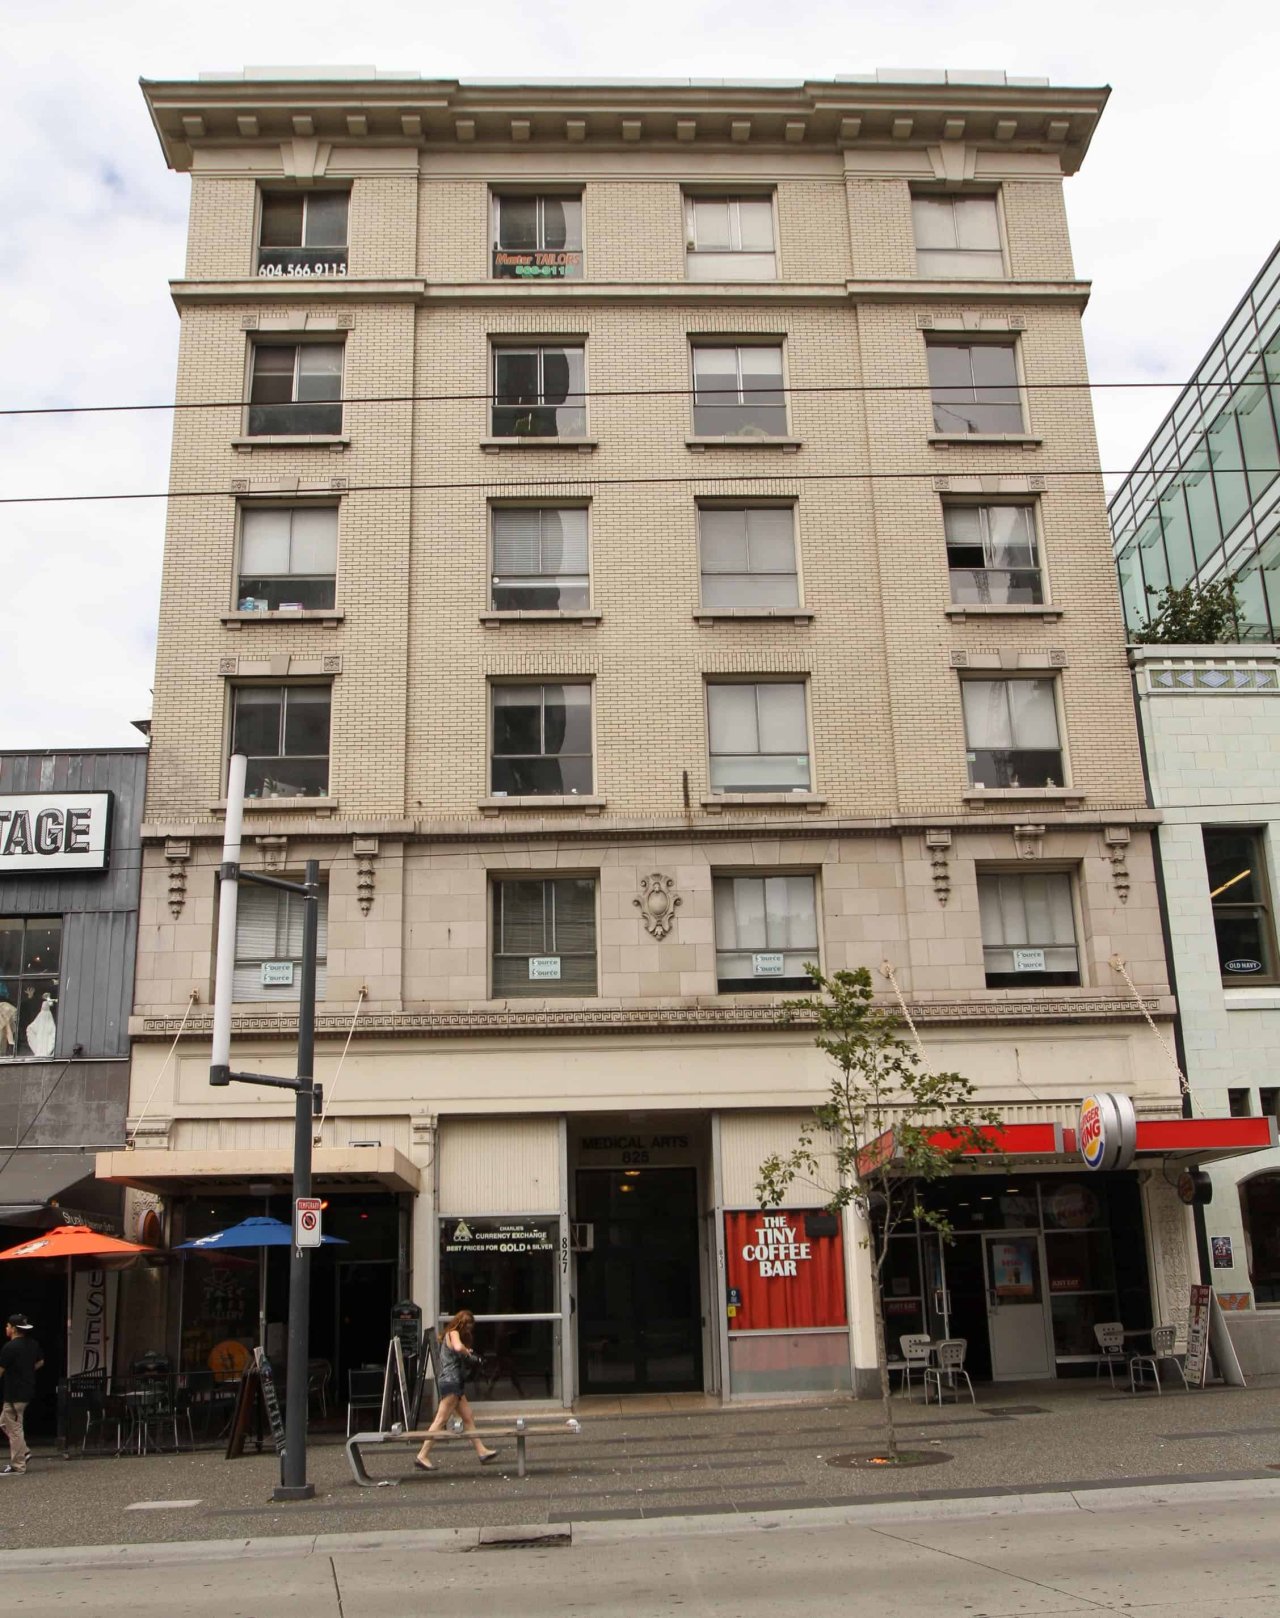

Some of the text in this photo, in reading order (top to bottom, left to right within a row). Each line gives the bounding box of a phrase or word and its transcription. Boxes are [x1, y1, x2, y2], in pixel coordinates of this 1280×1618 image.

[258, 263, 346, 277] 604.566.9115
[582, 1135, 689, 1150] MEDICAL ARTS
[622, 1151, 650, 1163] 825
[762, 1216, 788, 1228] THE
[511, 1231, 547, 1239] EXCHANGE
[755, 1227, 797, 1244] TINY
[499, 1243, 526, 1252] GOLD
[742, 1243, 812, 1261] COFFEE
[759, 1260, 797, 1277] BAR
[82, 1270, 105, 1373] USED
